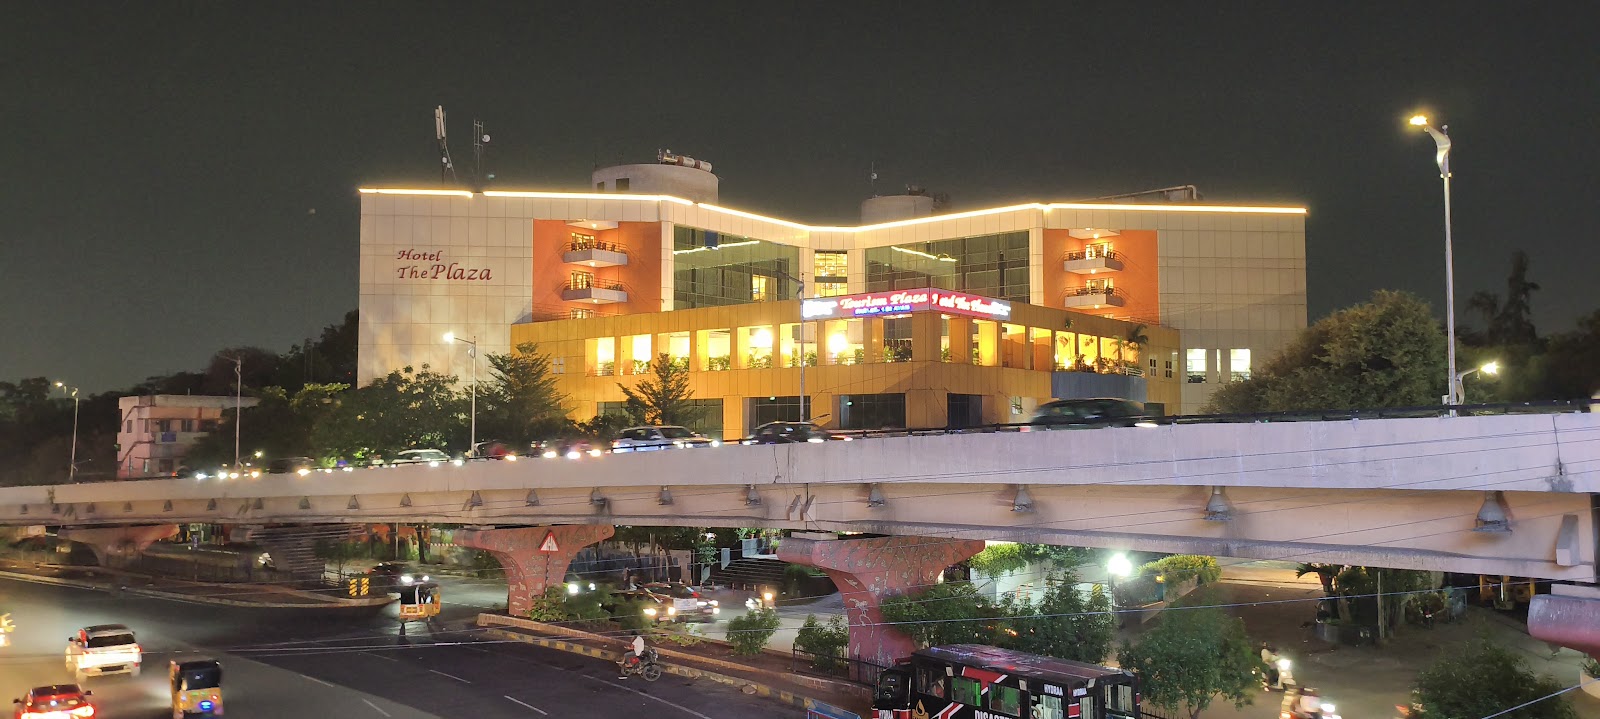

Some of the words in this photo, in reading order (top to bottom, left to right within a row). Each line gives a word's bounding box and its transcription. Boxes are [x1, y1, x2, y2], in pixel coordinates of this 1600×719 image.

[397, 248, 443, 261] Hotel
[397, 265, 428, 279] The
[430, 262, 492, 281] Plaza
[840, 295, 887, 309] Tourism
[889, 292, 928, 305] Plaza
